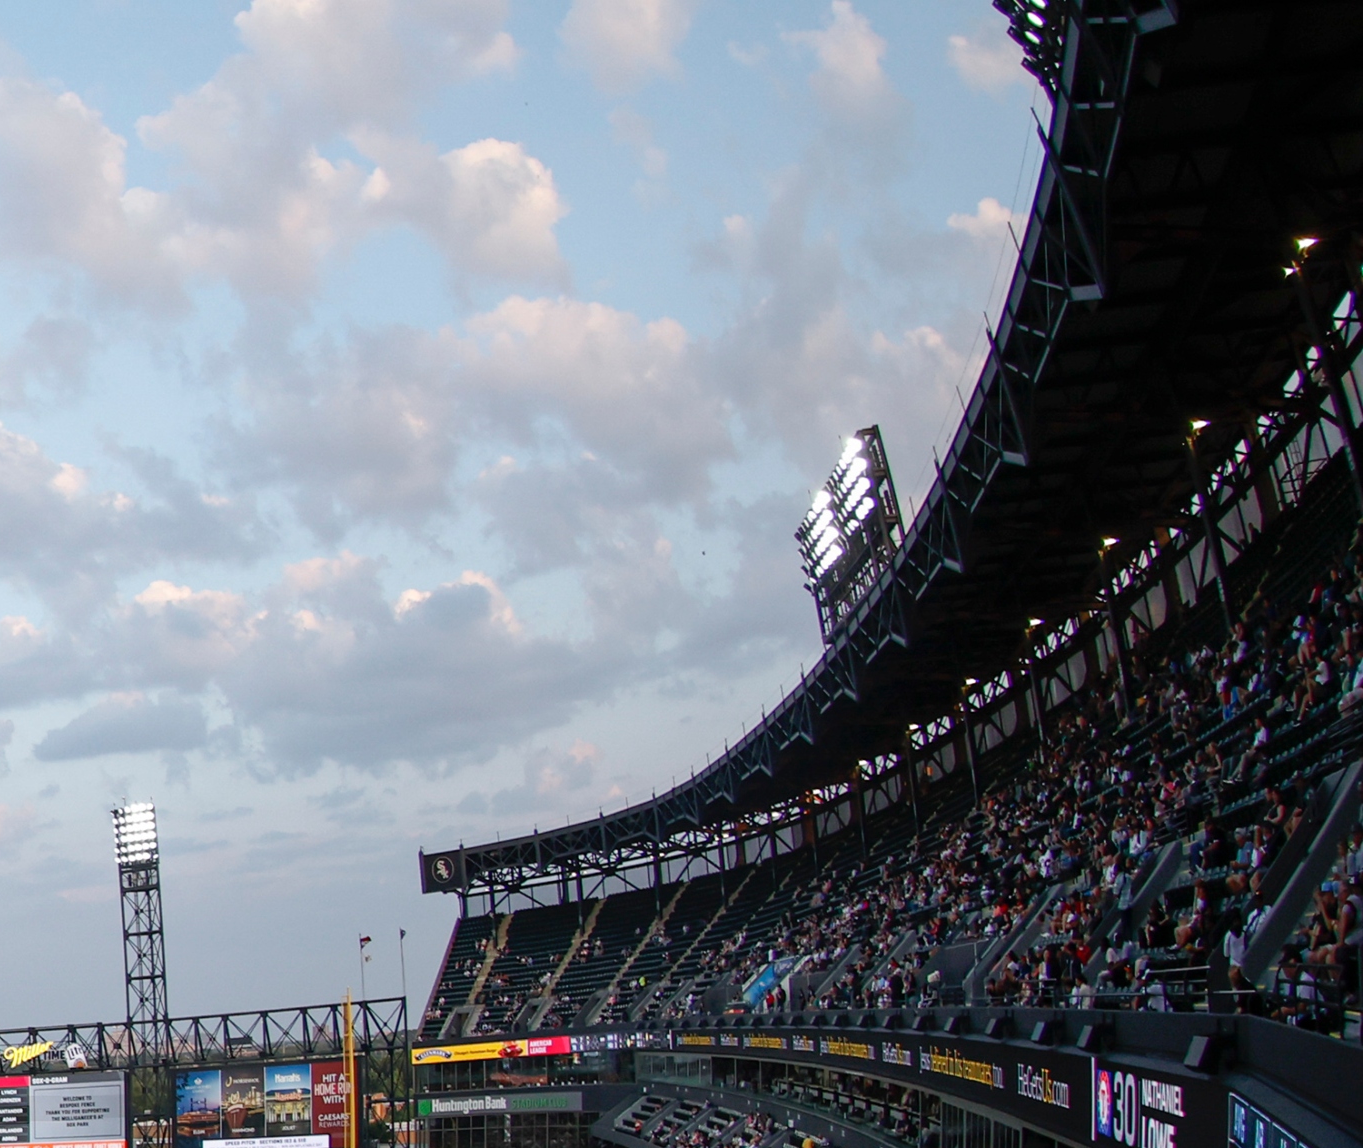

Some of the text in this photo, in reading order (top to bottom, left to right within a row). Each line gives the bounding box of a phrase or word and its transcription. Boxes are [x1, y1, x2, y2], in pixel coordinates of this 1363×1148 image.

[4, 1041, 54, 1069] Miller
[43, 1051, 65, 1061] TIME
[65, 1044, 84, 1060] Lite
[529, 1046, 547, 1054] LEAGUE
[322, 1073, 337, 1083] HIT
[314, 1083, 335, 1096] HOME
[1018, 1063, 1070, 1109] HeGetsUs.com
[322, 1095, 346, 1105] WITH
[1141, 1078, 1186, 1117] NATHANIEL
[431, 1096, 507, 1115] Huntington Bank
[1113, 1070, 1138, 1148] 30
[317, 1113, 350, 1122] CAESARS
